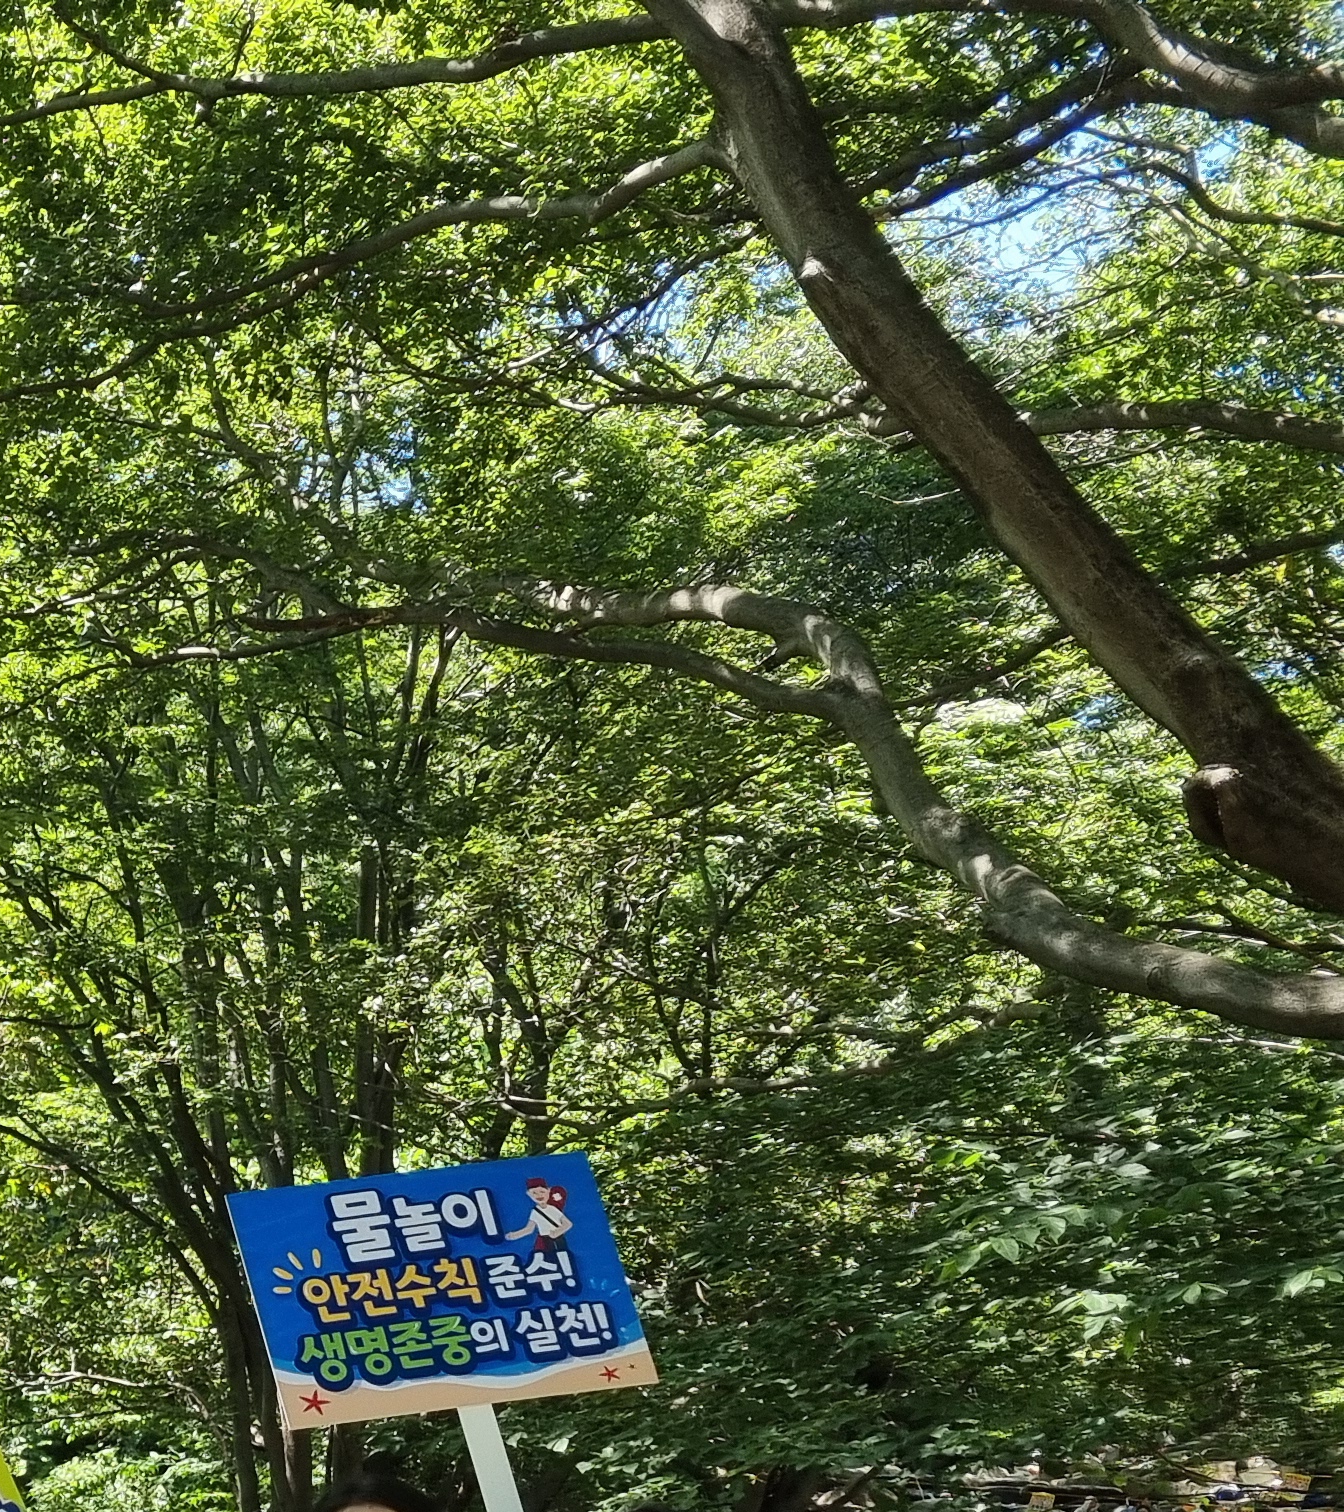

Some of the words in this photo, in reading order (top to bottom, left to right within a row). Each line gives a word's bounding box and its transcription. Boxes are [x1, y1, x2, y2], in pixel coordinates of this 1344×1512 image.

[330, 1189, 499, 1264] 물놀이
[302, 1257, 482, 1324] 안전수칙
[488, 1250, 577, 1300] 준수!
[300, 1315, 510, 1382] 생명존중의
[516, 1303, 613, 1353] 실천!
